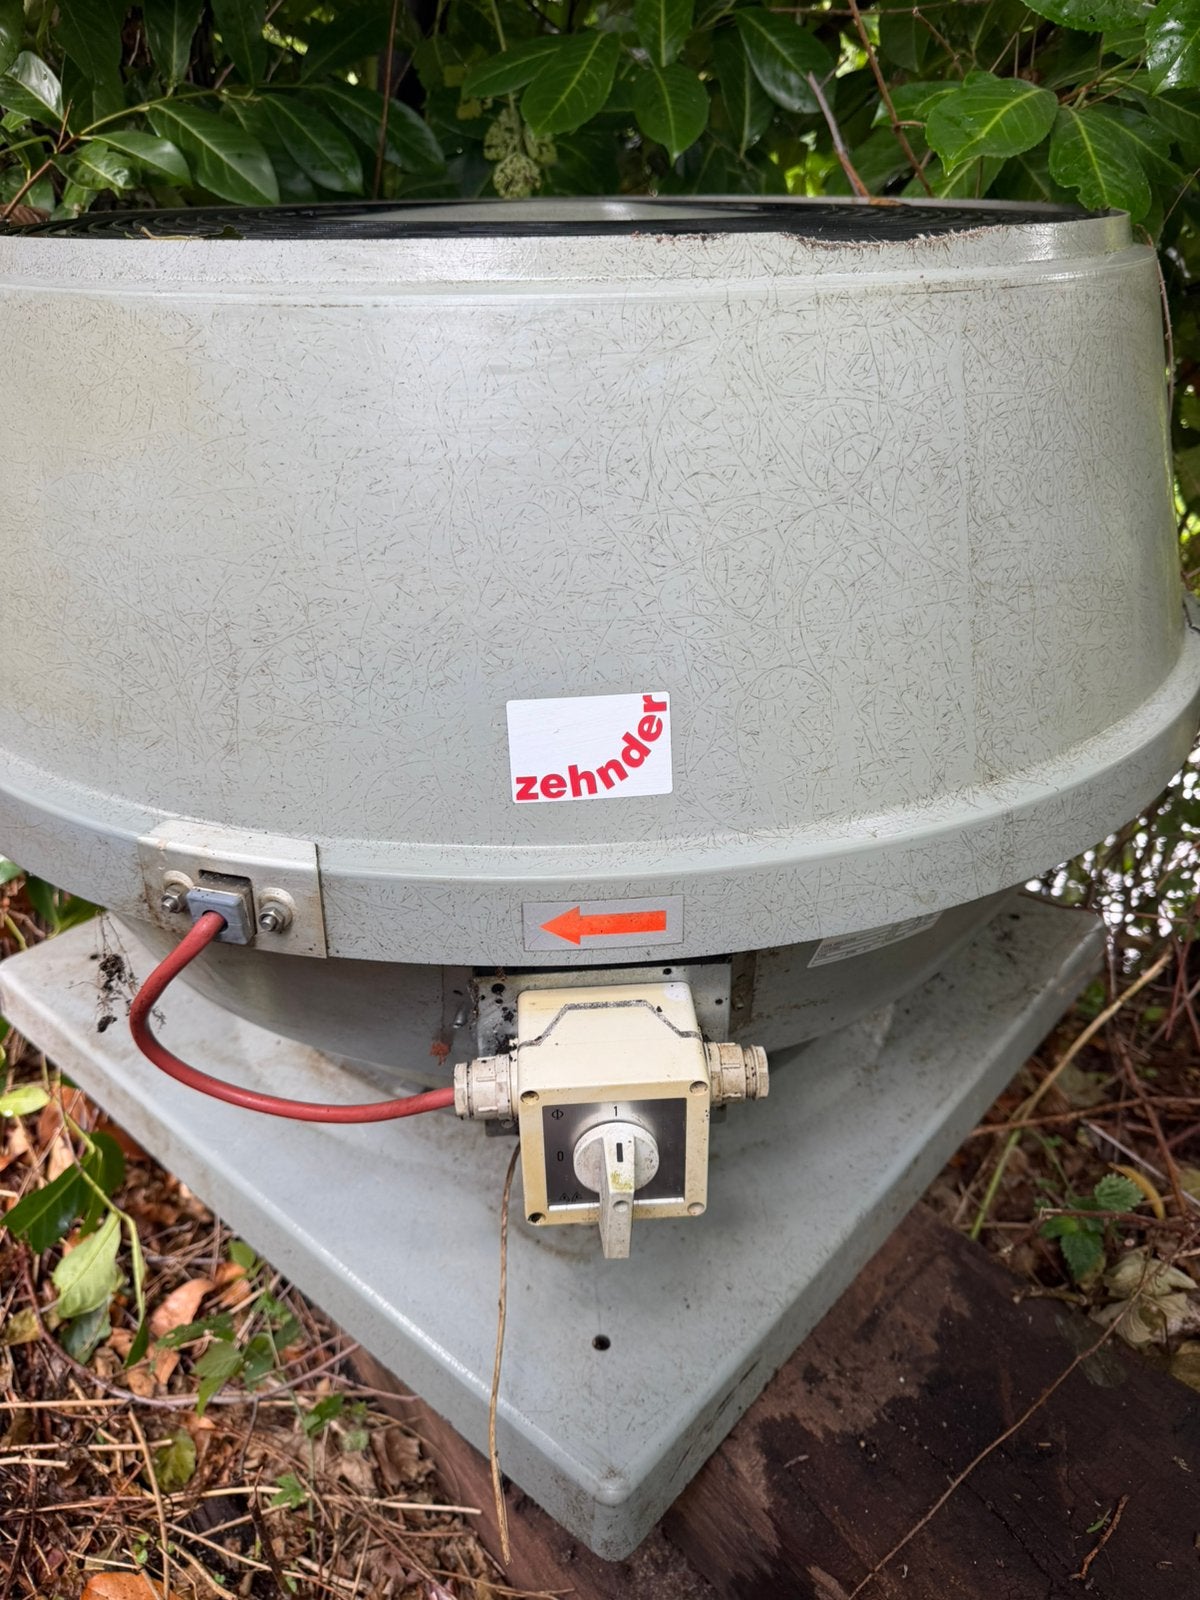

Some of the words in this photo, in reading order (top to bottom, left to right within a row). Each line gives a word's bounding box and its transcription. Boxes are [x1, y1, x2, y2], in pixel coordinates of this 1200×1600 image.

[515, 694, 667, 801] zehnder
[613, 1105, 618, 1117] 1
[557, 1151, 564, 1161] 0
